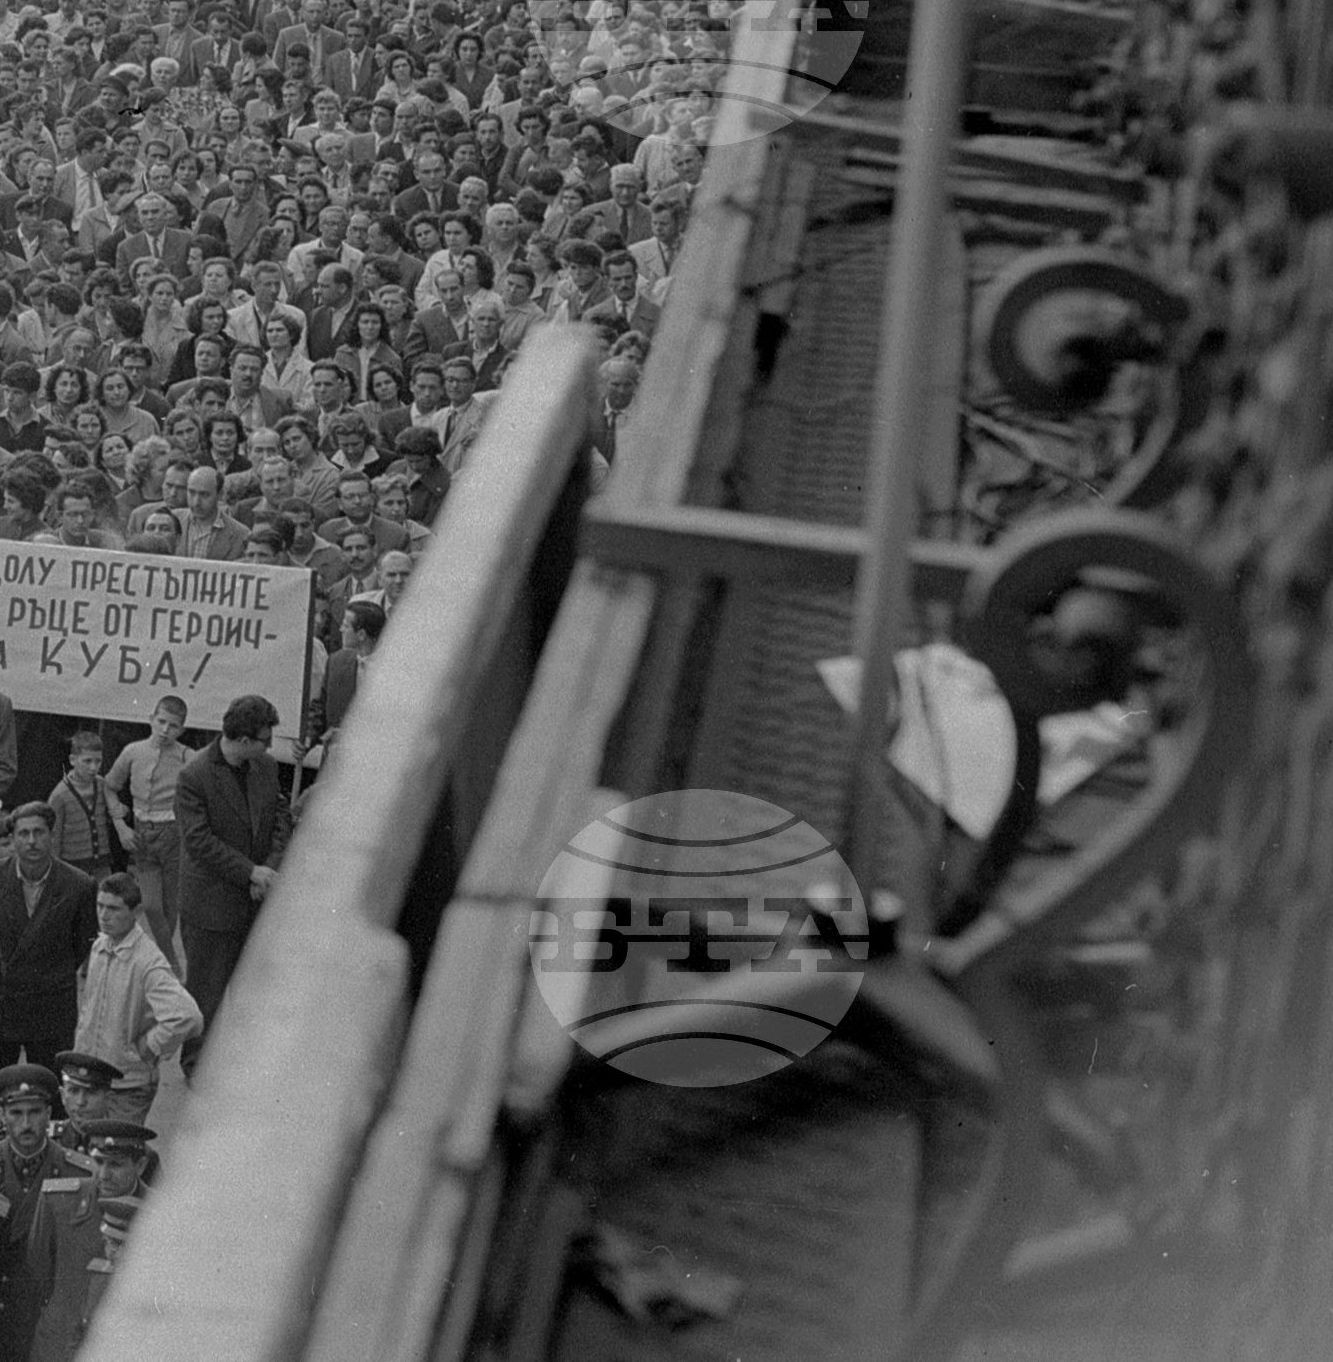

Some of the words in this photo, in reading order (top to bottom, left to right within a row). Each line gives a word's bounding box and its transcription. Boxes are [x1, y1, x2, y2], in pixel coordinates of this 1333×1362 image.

[70, 558, 271, 611] ПРЕСТЪПНИТЕ
[7, 598, 91, 638] РЪЦЕ
[102, 603, 138, 638] ОТ
[150, 608, 278, 650] ГЕРОИЧ-
[40, 636, 212, 690] КУБА!
